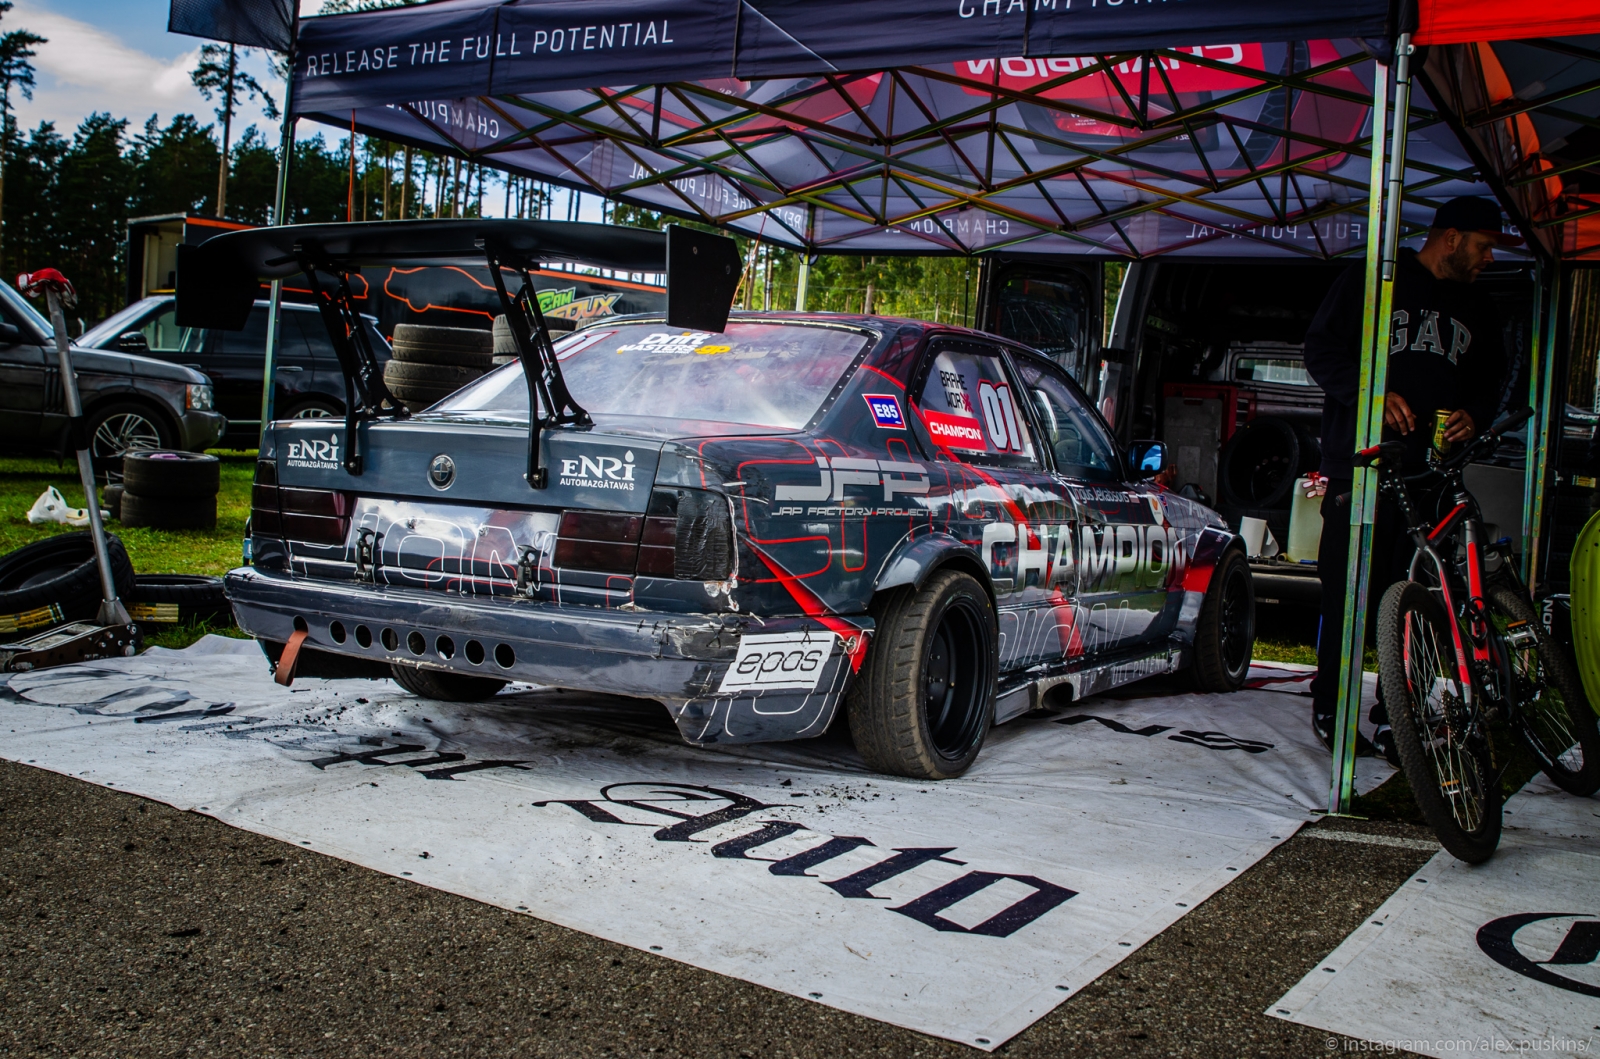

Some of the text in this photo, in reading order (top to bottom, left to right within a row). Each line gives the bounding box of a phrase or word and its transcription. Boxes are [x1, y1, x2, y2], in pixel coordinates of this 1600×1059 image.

[306, 19, 674, 77] RELEASE THE FULL POTENTIAL
[537, 288, 574, 314] EAM
[545, 295, 617, 321] EDUX
[638, 332, 712, 346] Drift
[1390, 309, 1472, 366] GAP
[940, 370, 968, 391] BRAKE
[872, 403, 899, 419] E85
[979, 380, 1022, 452] 01
[929, 421, 982, 441] CHAMPION
[775, 456, 931, 502] JFP
[771, 506, 939, 517] JAP FACTORY PROJECTS
[981, 521, 1187, 598] CHAMPION
[736, 650, 823, 681] epos
[1106, 665, 1128, 687] ULL
[531, 781, 1080, 938] Auto
